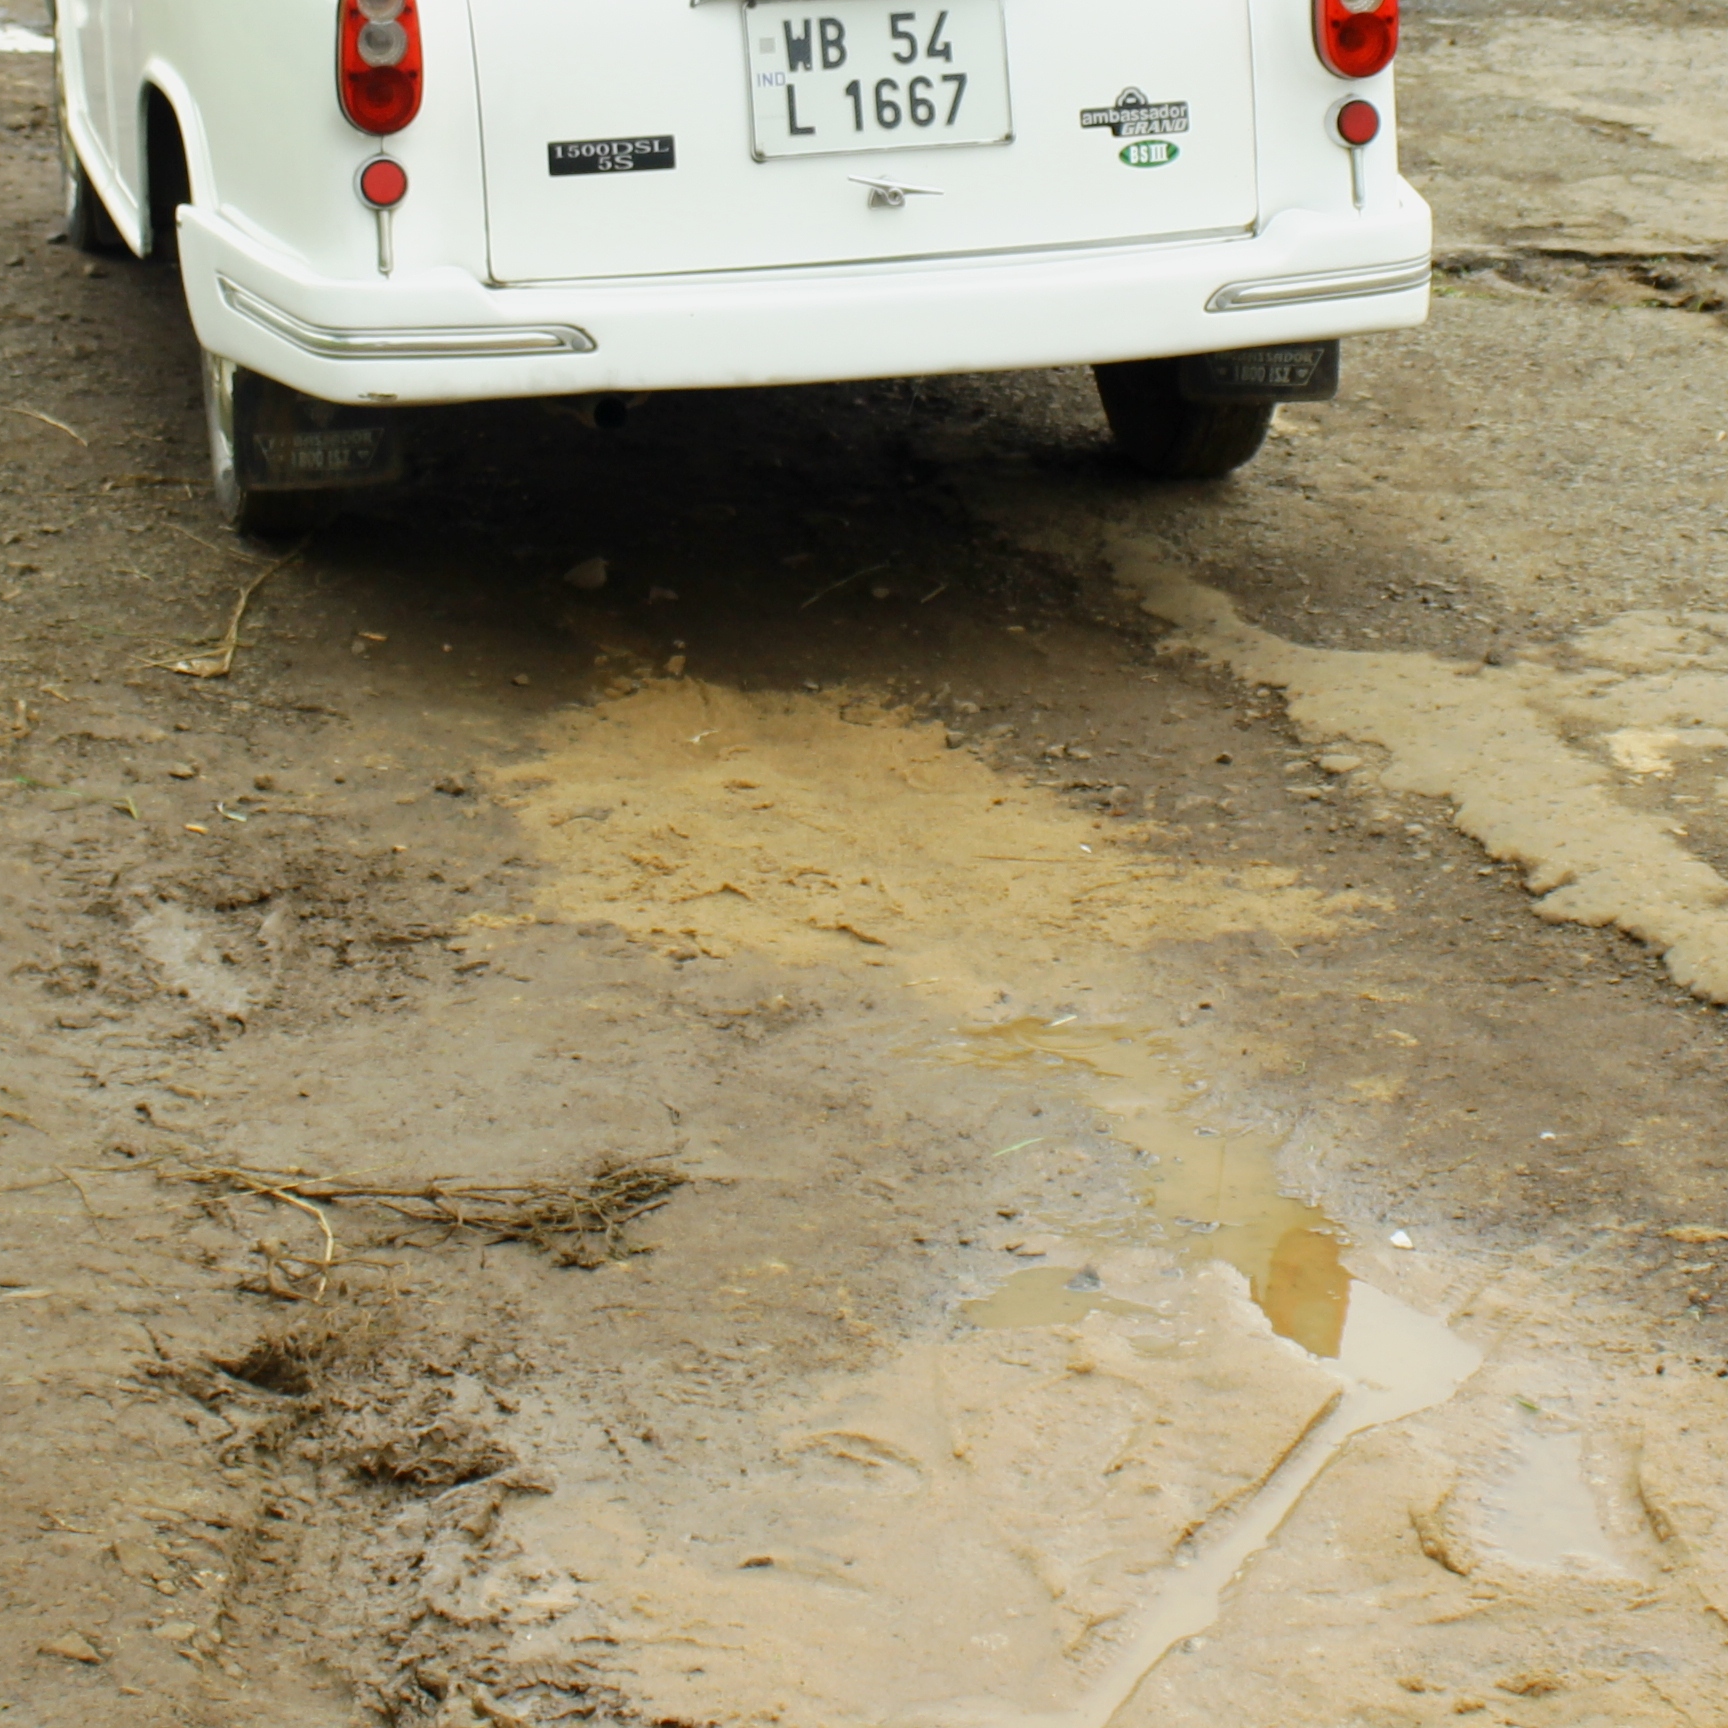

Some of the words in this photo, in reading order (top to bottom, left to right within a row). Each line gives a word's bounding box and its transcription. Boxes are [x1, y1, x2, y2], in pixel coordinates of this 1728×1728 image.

[782, 17, 848, 72] WB
[889, 9, 953, 64] 54
[757, 71, 786, 87] IND
[786, 83, 816, 136] L
[845, 73, 968, 132] 1667
[1082, 105, 1188, 126] ambassador
[1121, 118, 1188, 136] GRAND
[554, 139, 670, 159] 1500DSL
[597, 155, 635, 171] 5S
